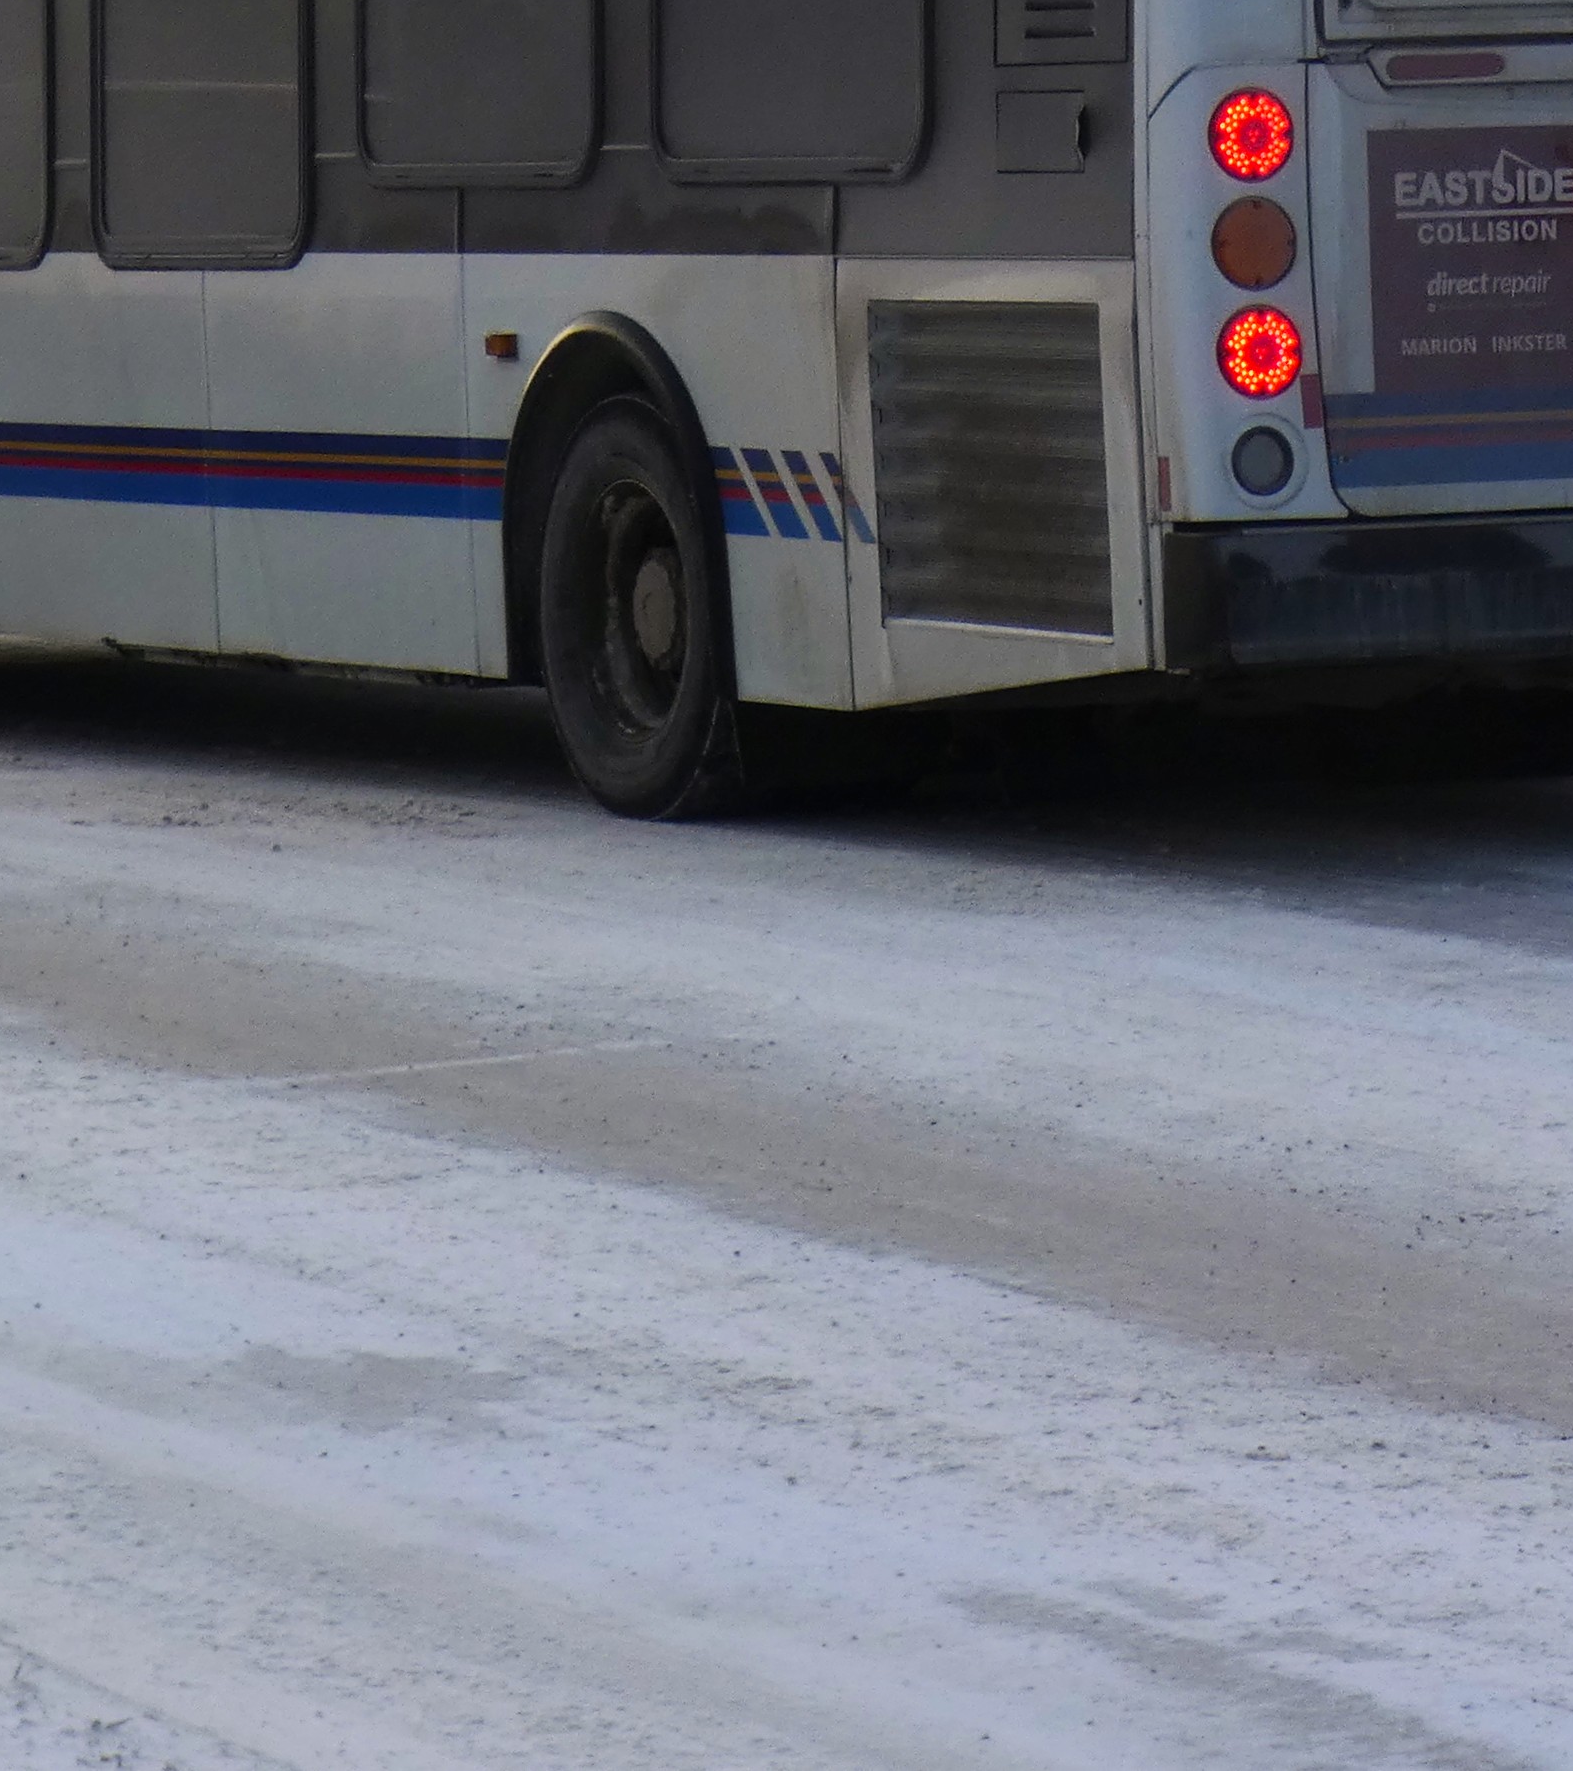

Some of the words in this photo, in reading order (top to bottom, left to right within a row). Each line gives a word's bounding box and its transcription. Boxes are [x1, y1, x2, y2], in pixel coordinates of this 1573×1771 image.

[1416, 218, 1559, 245] COLLISION
[1426, 270, 1489, 297] direct
[1491, 268, 1552, 298] repair
[1401, 336, 1476, 356] MARION
[1491, 333, 1568, 353] INKSTER
